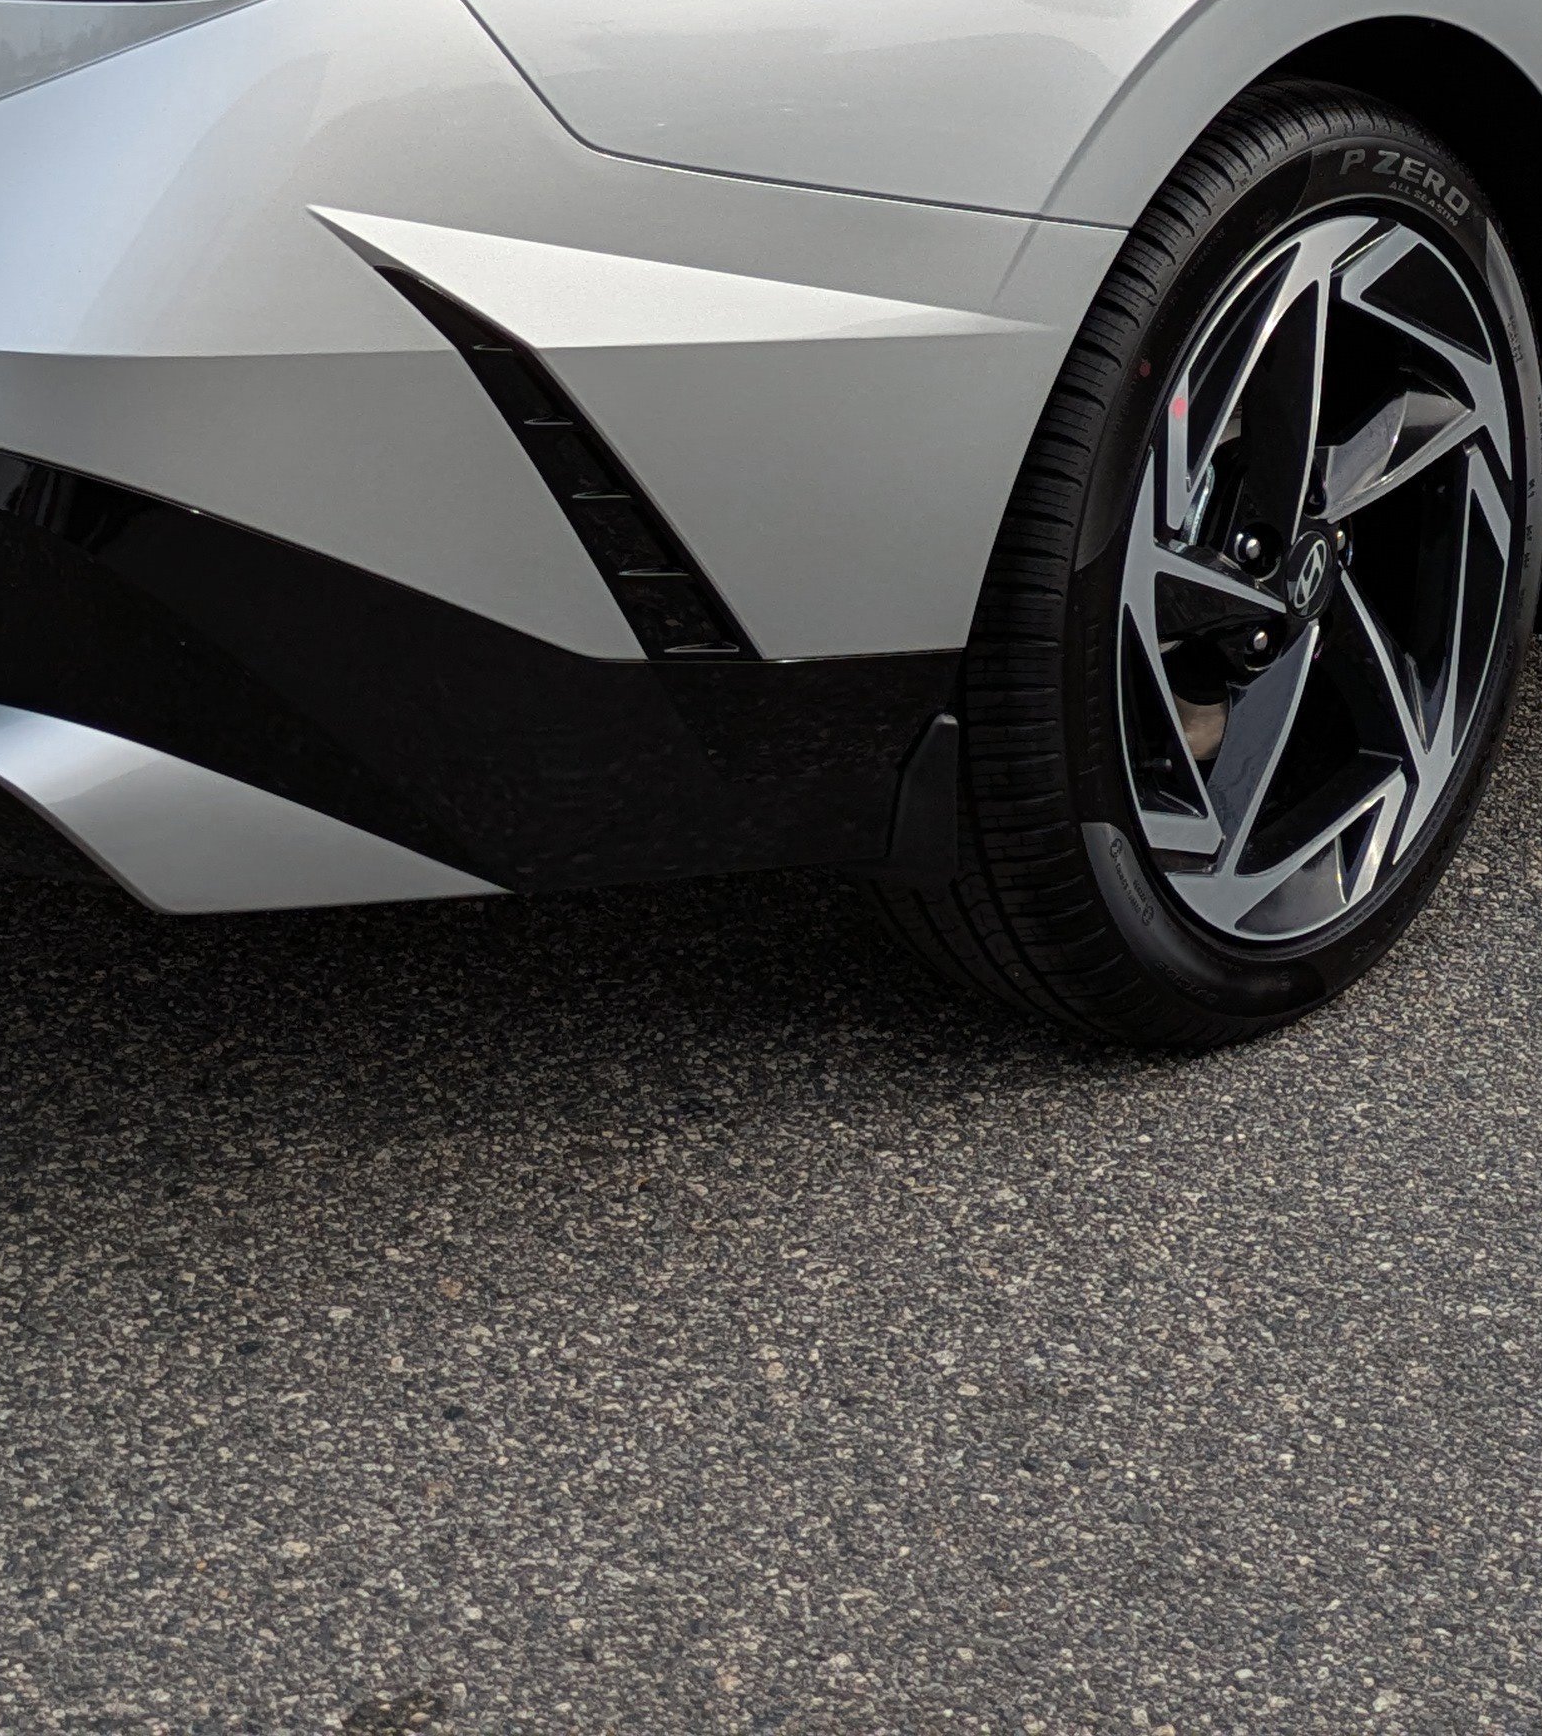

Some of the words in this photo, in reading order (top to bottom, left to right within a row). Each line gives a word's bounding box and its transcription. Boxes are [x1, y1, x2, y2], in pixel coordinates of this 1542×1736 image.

[1339, 148, 1367, 176] P
[1371, 149, 1471, 217] ZERO
[1388, 180, 1411, 196] ALL
